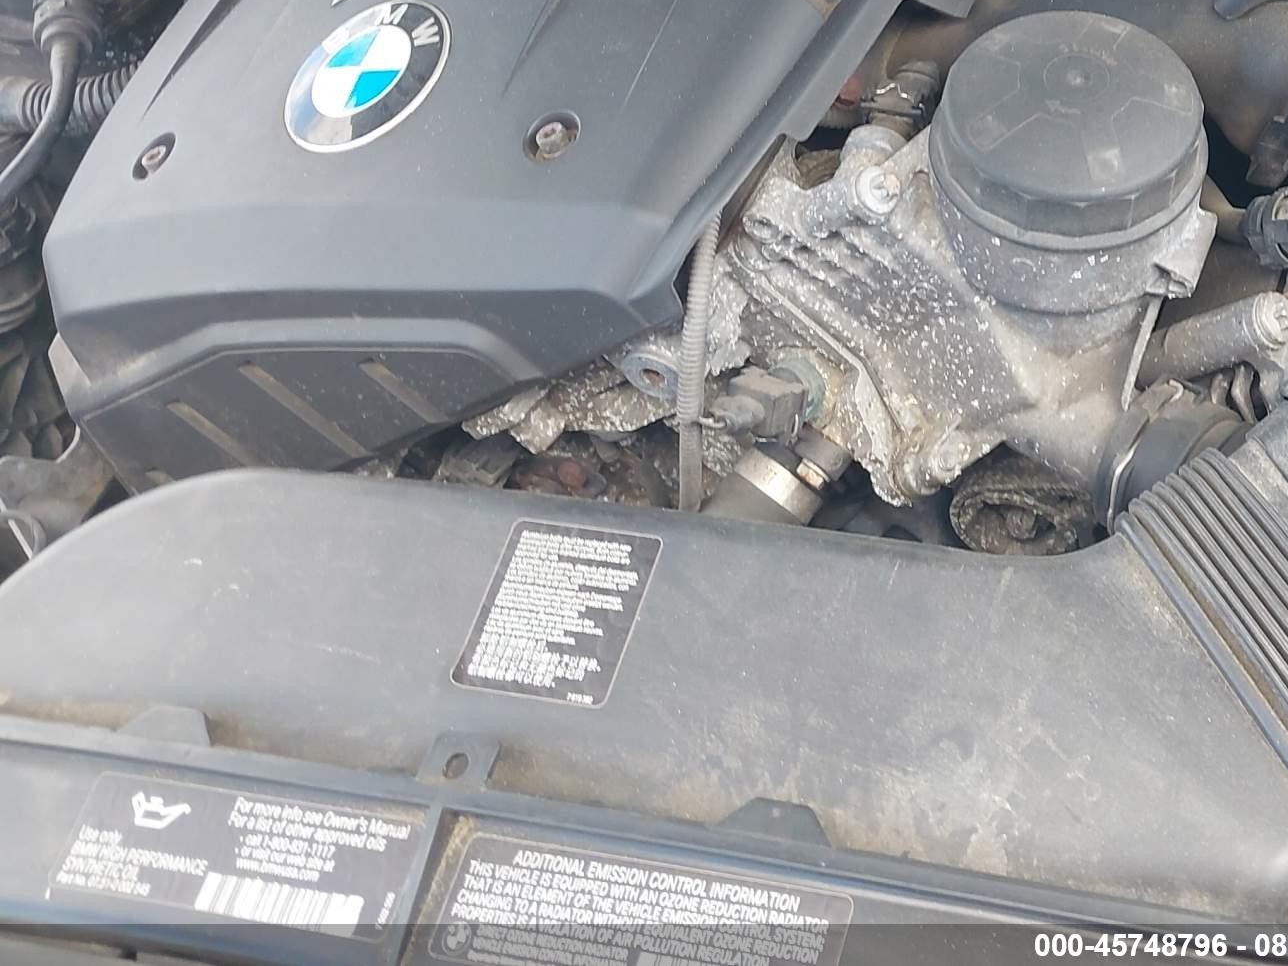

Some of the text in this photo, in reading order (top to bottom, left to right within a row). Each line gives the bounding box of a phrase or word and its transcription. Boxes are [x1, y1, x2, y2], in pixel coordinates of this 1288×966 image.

[235, 796, 411, 840] For more info see Owner's Manual
[255, 818, 272, 832] list
[273, 820, 287, 834] of
[286, 822, 315, 839] other
[315, 828, 367, 849] approved
[126, 848, 209, 876] PERFORMANCE
[513, 849, 801, 913] ADDITIONAL EMISSION CONTROL INFORMATION
[463, 874, 491, 891] THAT
[493, 879, 503, 893] IS
[503, 881, 522, 896] AN
[521, 884, 574, 906] ELEMENT
[574, 894, 592, 909] OF
[592, 895, 614, 913] THE
[615, 899, 661, 921] VEHICLE
[661, 908, 719, 930] EMISSION
[718, 918, 772, 940] CONTROL
[469, 859, 829, 934] THIS VEHICLE IS EQUIPPED WITH AN OZONE REDUCTION RADIATOR
[451, 903, 517, 926] PROPERTIES
[538, 919, 596, 941] VIOLATION
[596, 928, 613, 943] OF
[612, 931, 634, 947] AIR
[634, 935, 698, 958] POLLUTION
[456, 889, 513, 912] CHANGING
[514, 898, 529, 914] TO
[538, 903, 594, 926] RADIATOR
[594, 913, 642, 934] WITHOUT
[642, 922, 713, 947] EQUIVALENT
[713, 932, 753, 951] OZONE
[753, 939, 821, 965] REDUCTION
